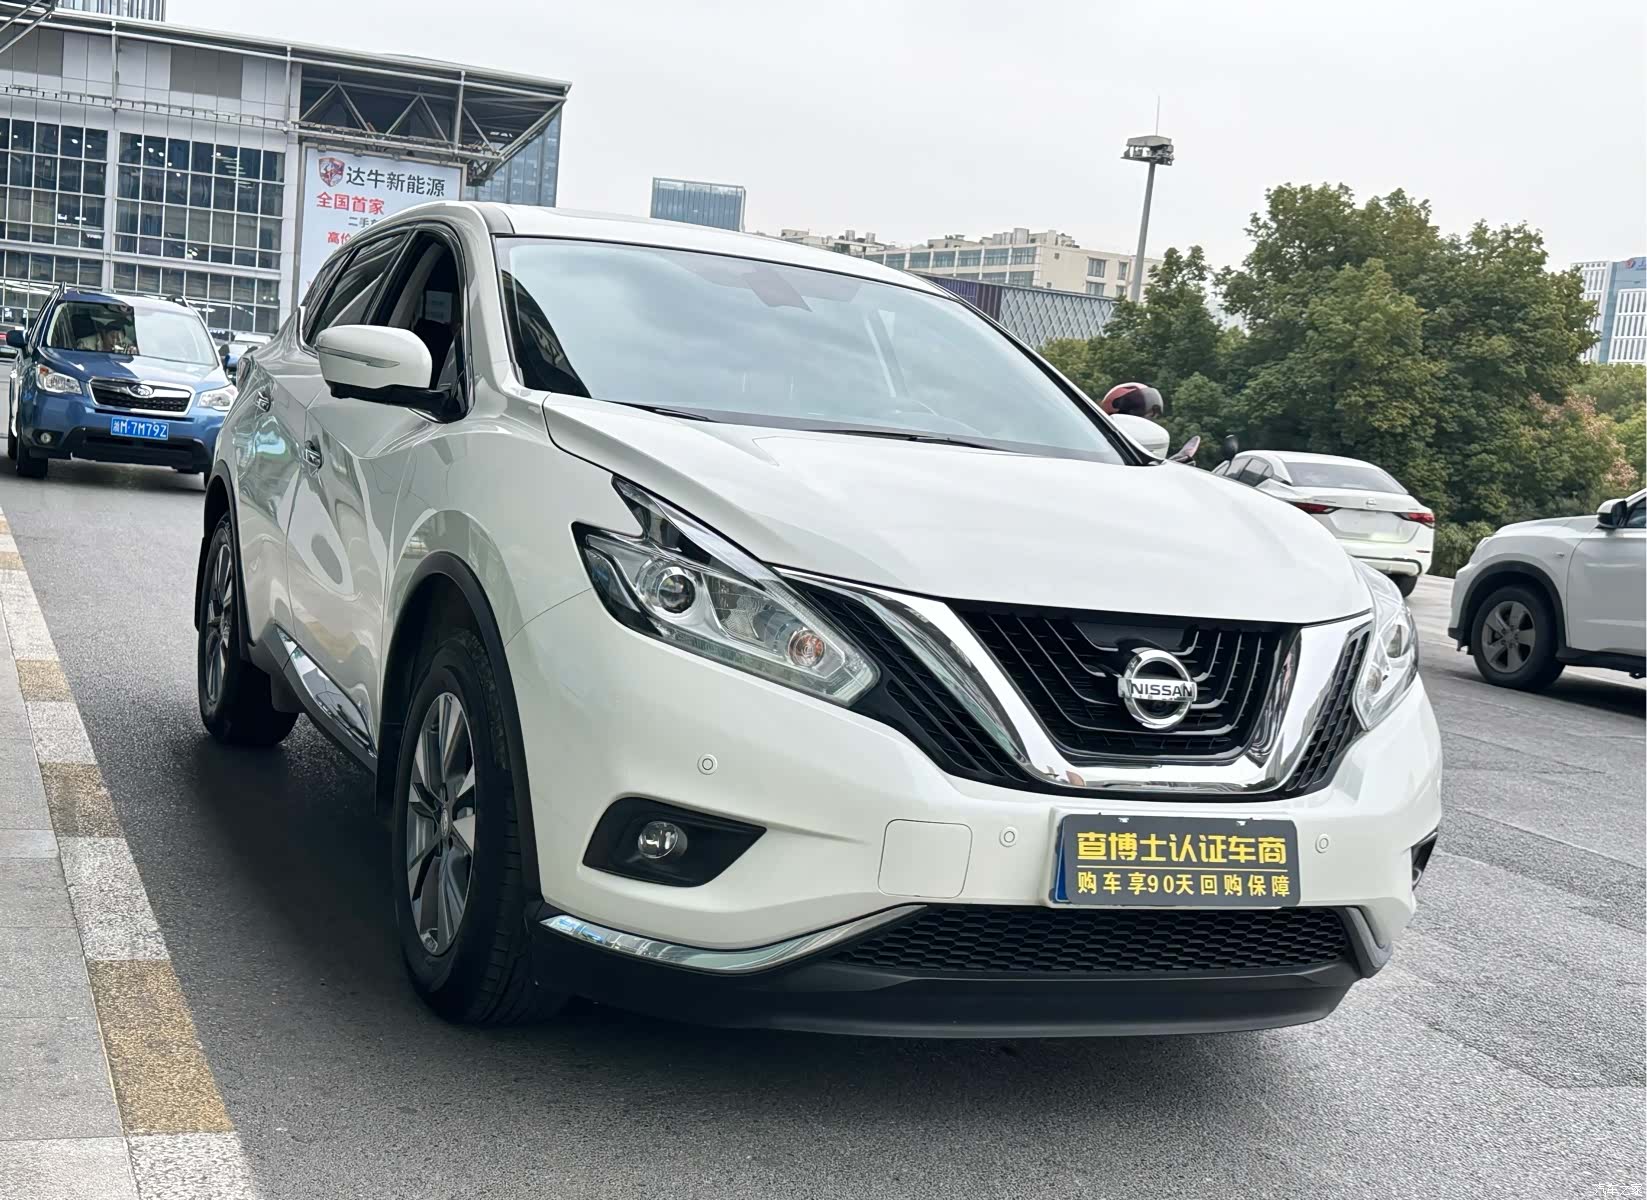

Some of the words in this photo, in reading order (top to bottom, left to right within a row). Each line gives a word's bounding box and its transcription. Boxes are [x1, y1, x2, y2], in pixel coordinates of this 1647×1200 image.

[346, 166, 446, 197] 达牛新能源
[316, 191, 385, 215] 全国首家
[1131, 683, 1193, 697] NISSAN
[1077, 831, 1287, 864] 查博士认证车商
